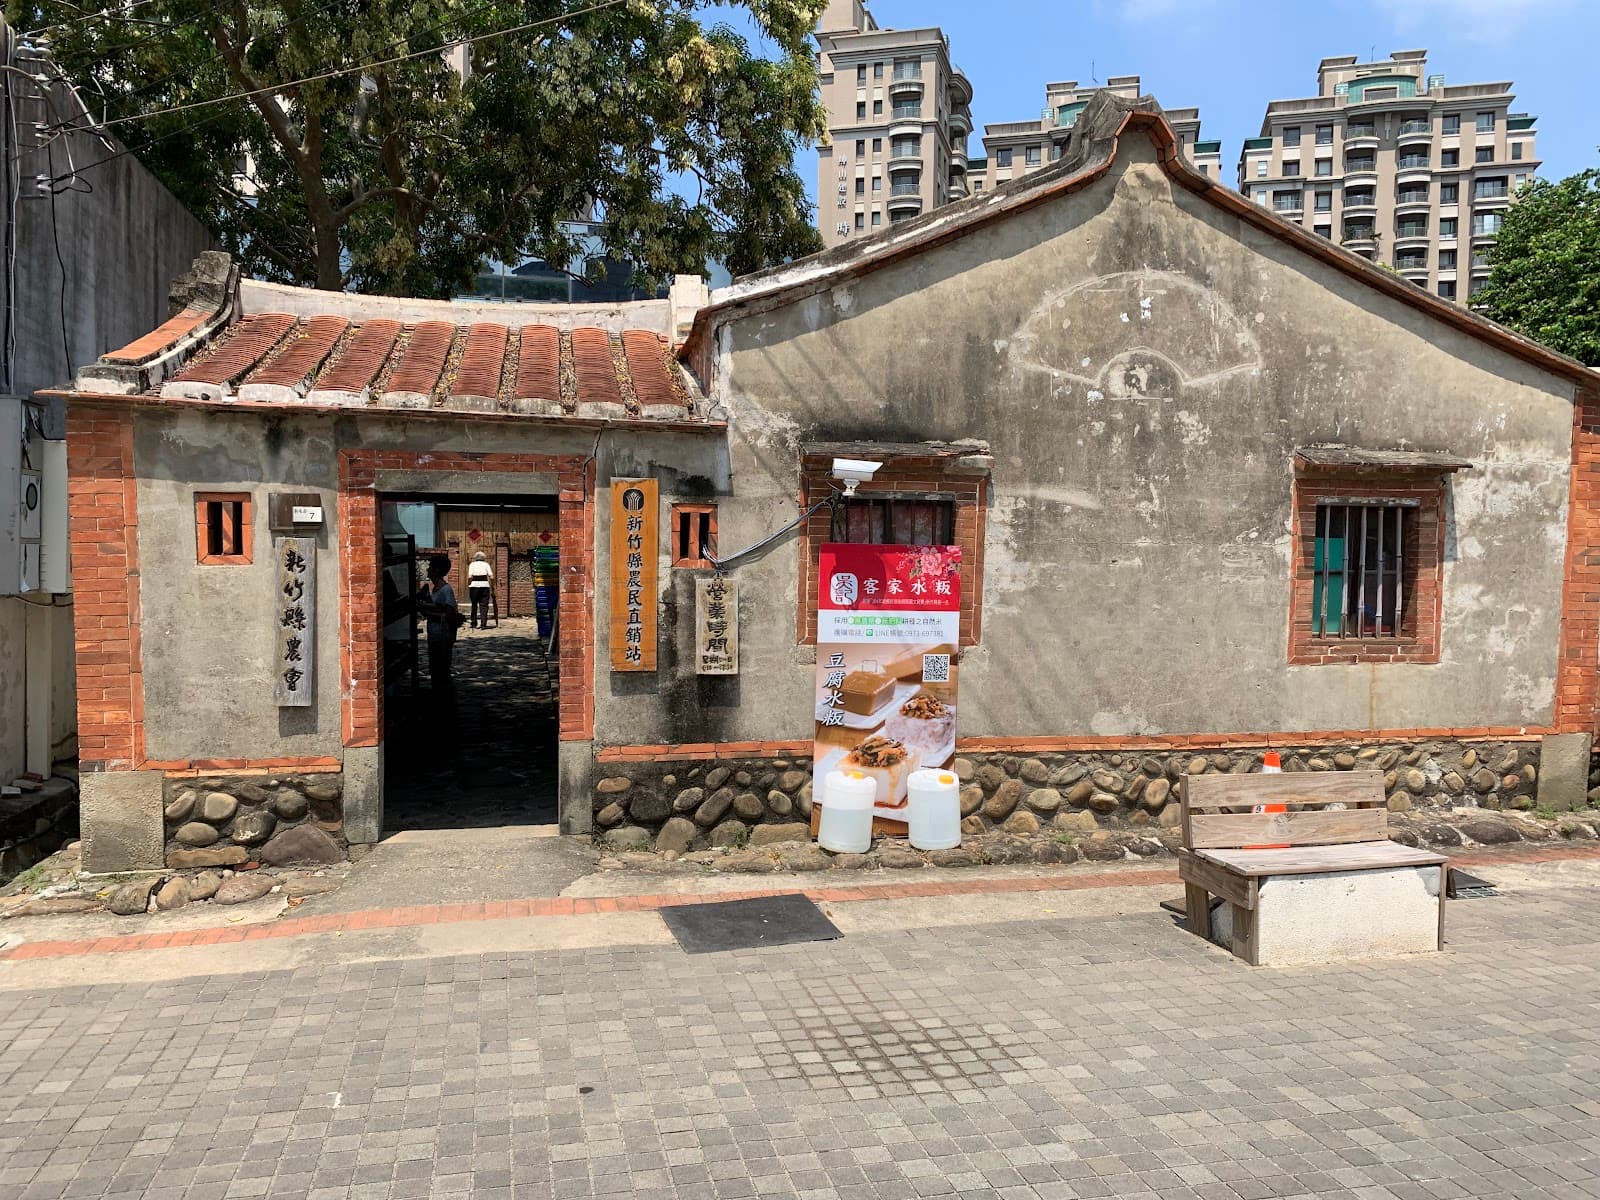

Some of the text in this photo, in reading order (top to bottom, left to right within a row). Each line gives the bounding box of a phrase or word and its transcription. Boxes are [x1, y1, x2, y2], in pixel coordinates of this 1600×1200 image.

[309, 512, 315, 520] 7
[280, 549, 307, 692] 新竹縣農會
[625, 515, 644, 661] 新竹縣農民直銷站
[706, 579, 729, 655] 營業時間
[835, 575, 855, 606] 吳記
[863, 578, 953, 596] 客家水粄
[821, 652, 847, 728] 豆腐水粄
